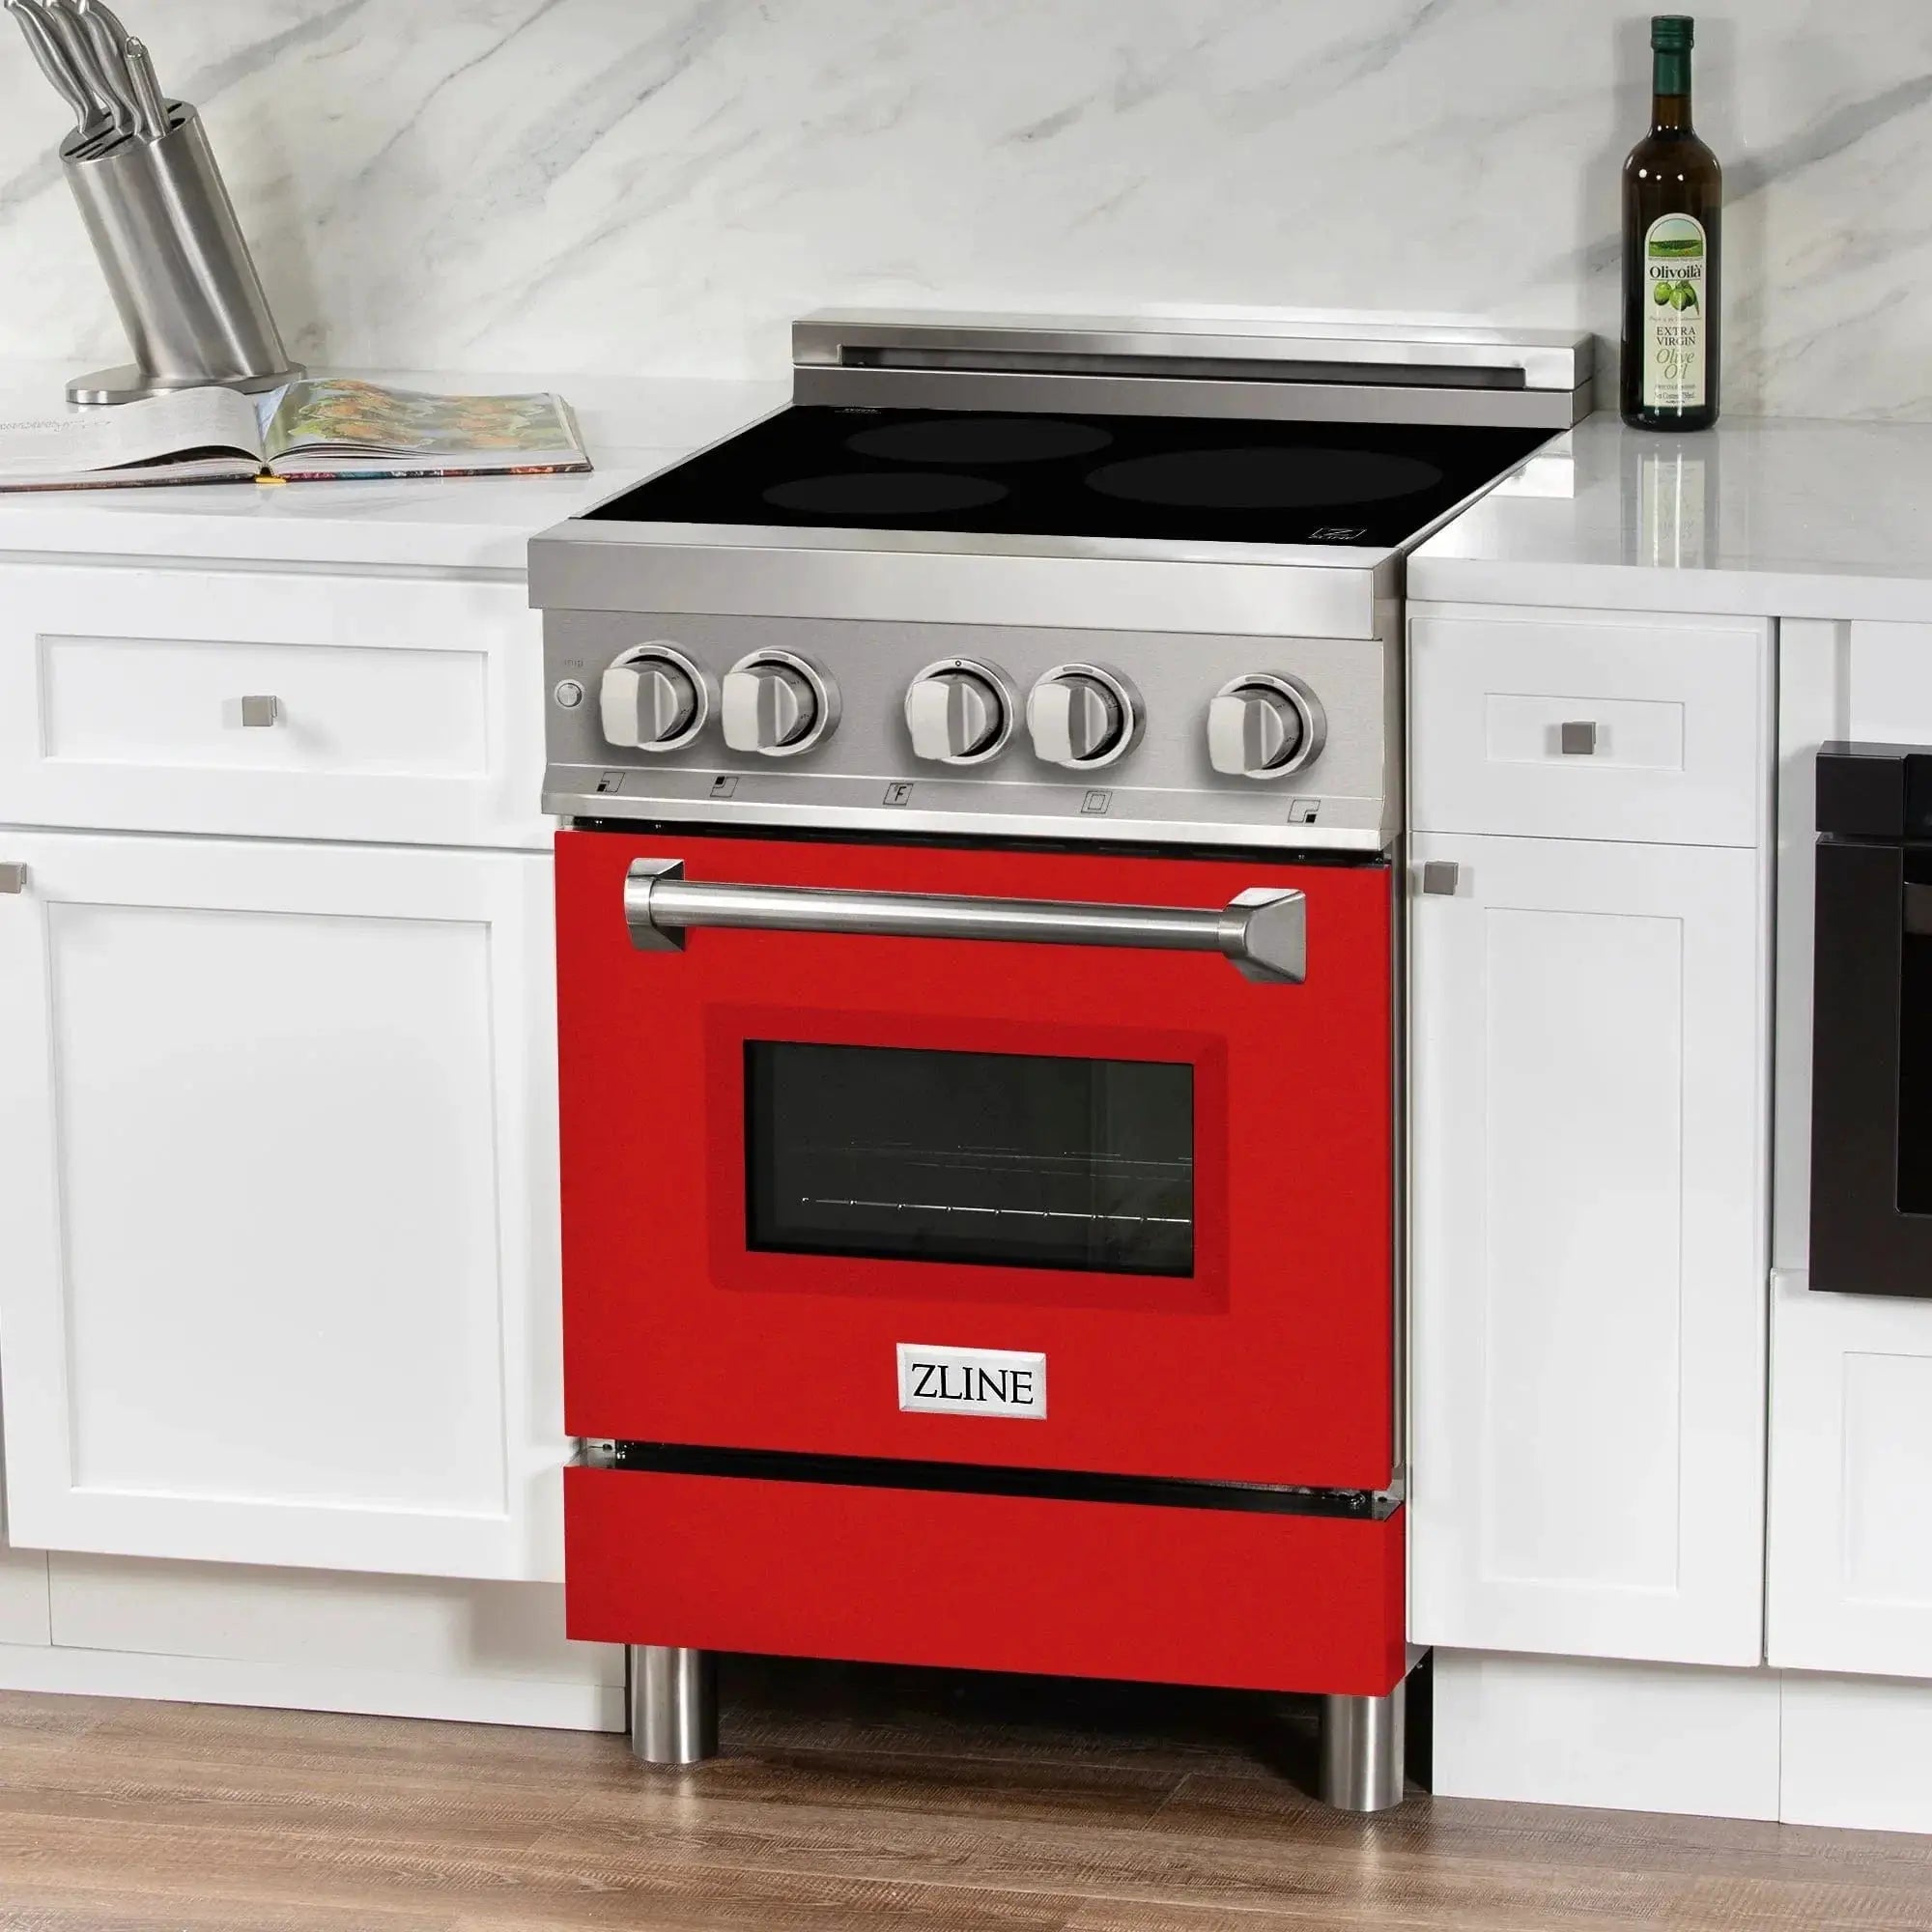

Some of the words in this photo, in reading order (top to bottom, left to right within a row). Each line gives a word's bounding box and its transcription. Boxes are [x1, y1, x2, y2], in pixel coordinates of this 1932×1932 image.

[1649, 264, 1701, 279] Olivoilà
[1656, 326, 1696, 336] EXTRA
[1656, 336, 1696, 347] VIRGIN
[1656, 348, 1695, 364] Olive
[911, 1363, 1034, 1405] ZLINE
